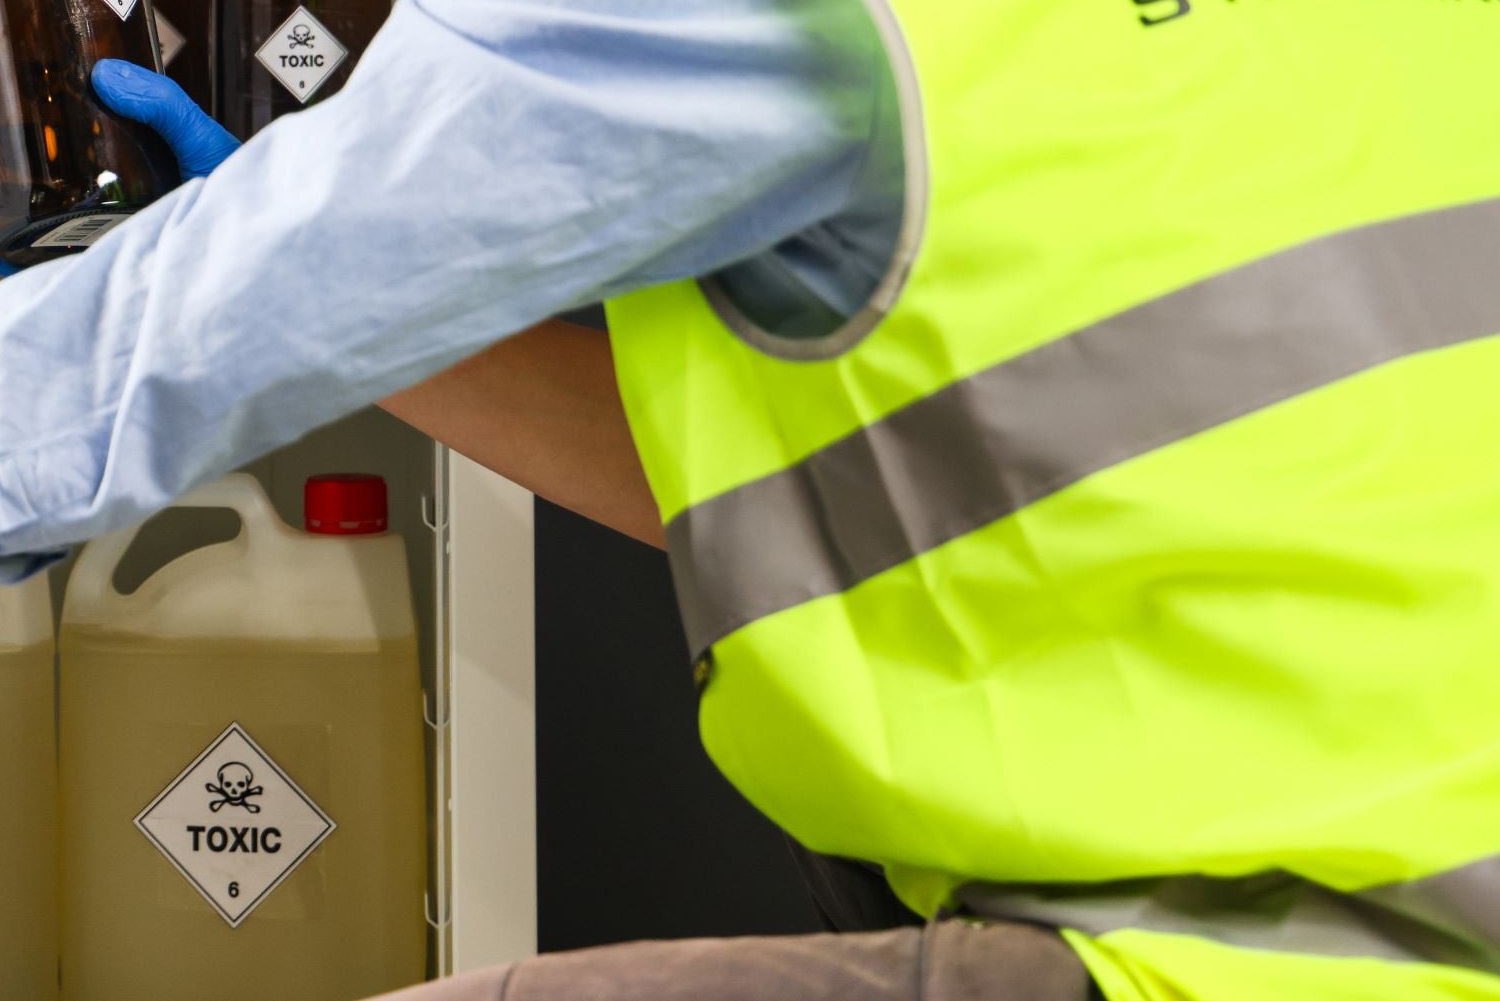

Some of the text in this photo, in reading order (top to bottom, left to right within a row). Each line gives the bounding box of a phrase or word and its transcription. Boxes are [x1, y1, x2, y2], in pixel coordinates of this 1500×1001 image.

[279, 55, 324, 67] TOXIC
[186, 826, 282, 853] TOXIC
[228, 881, 239, 898] 6
